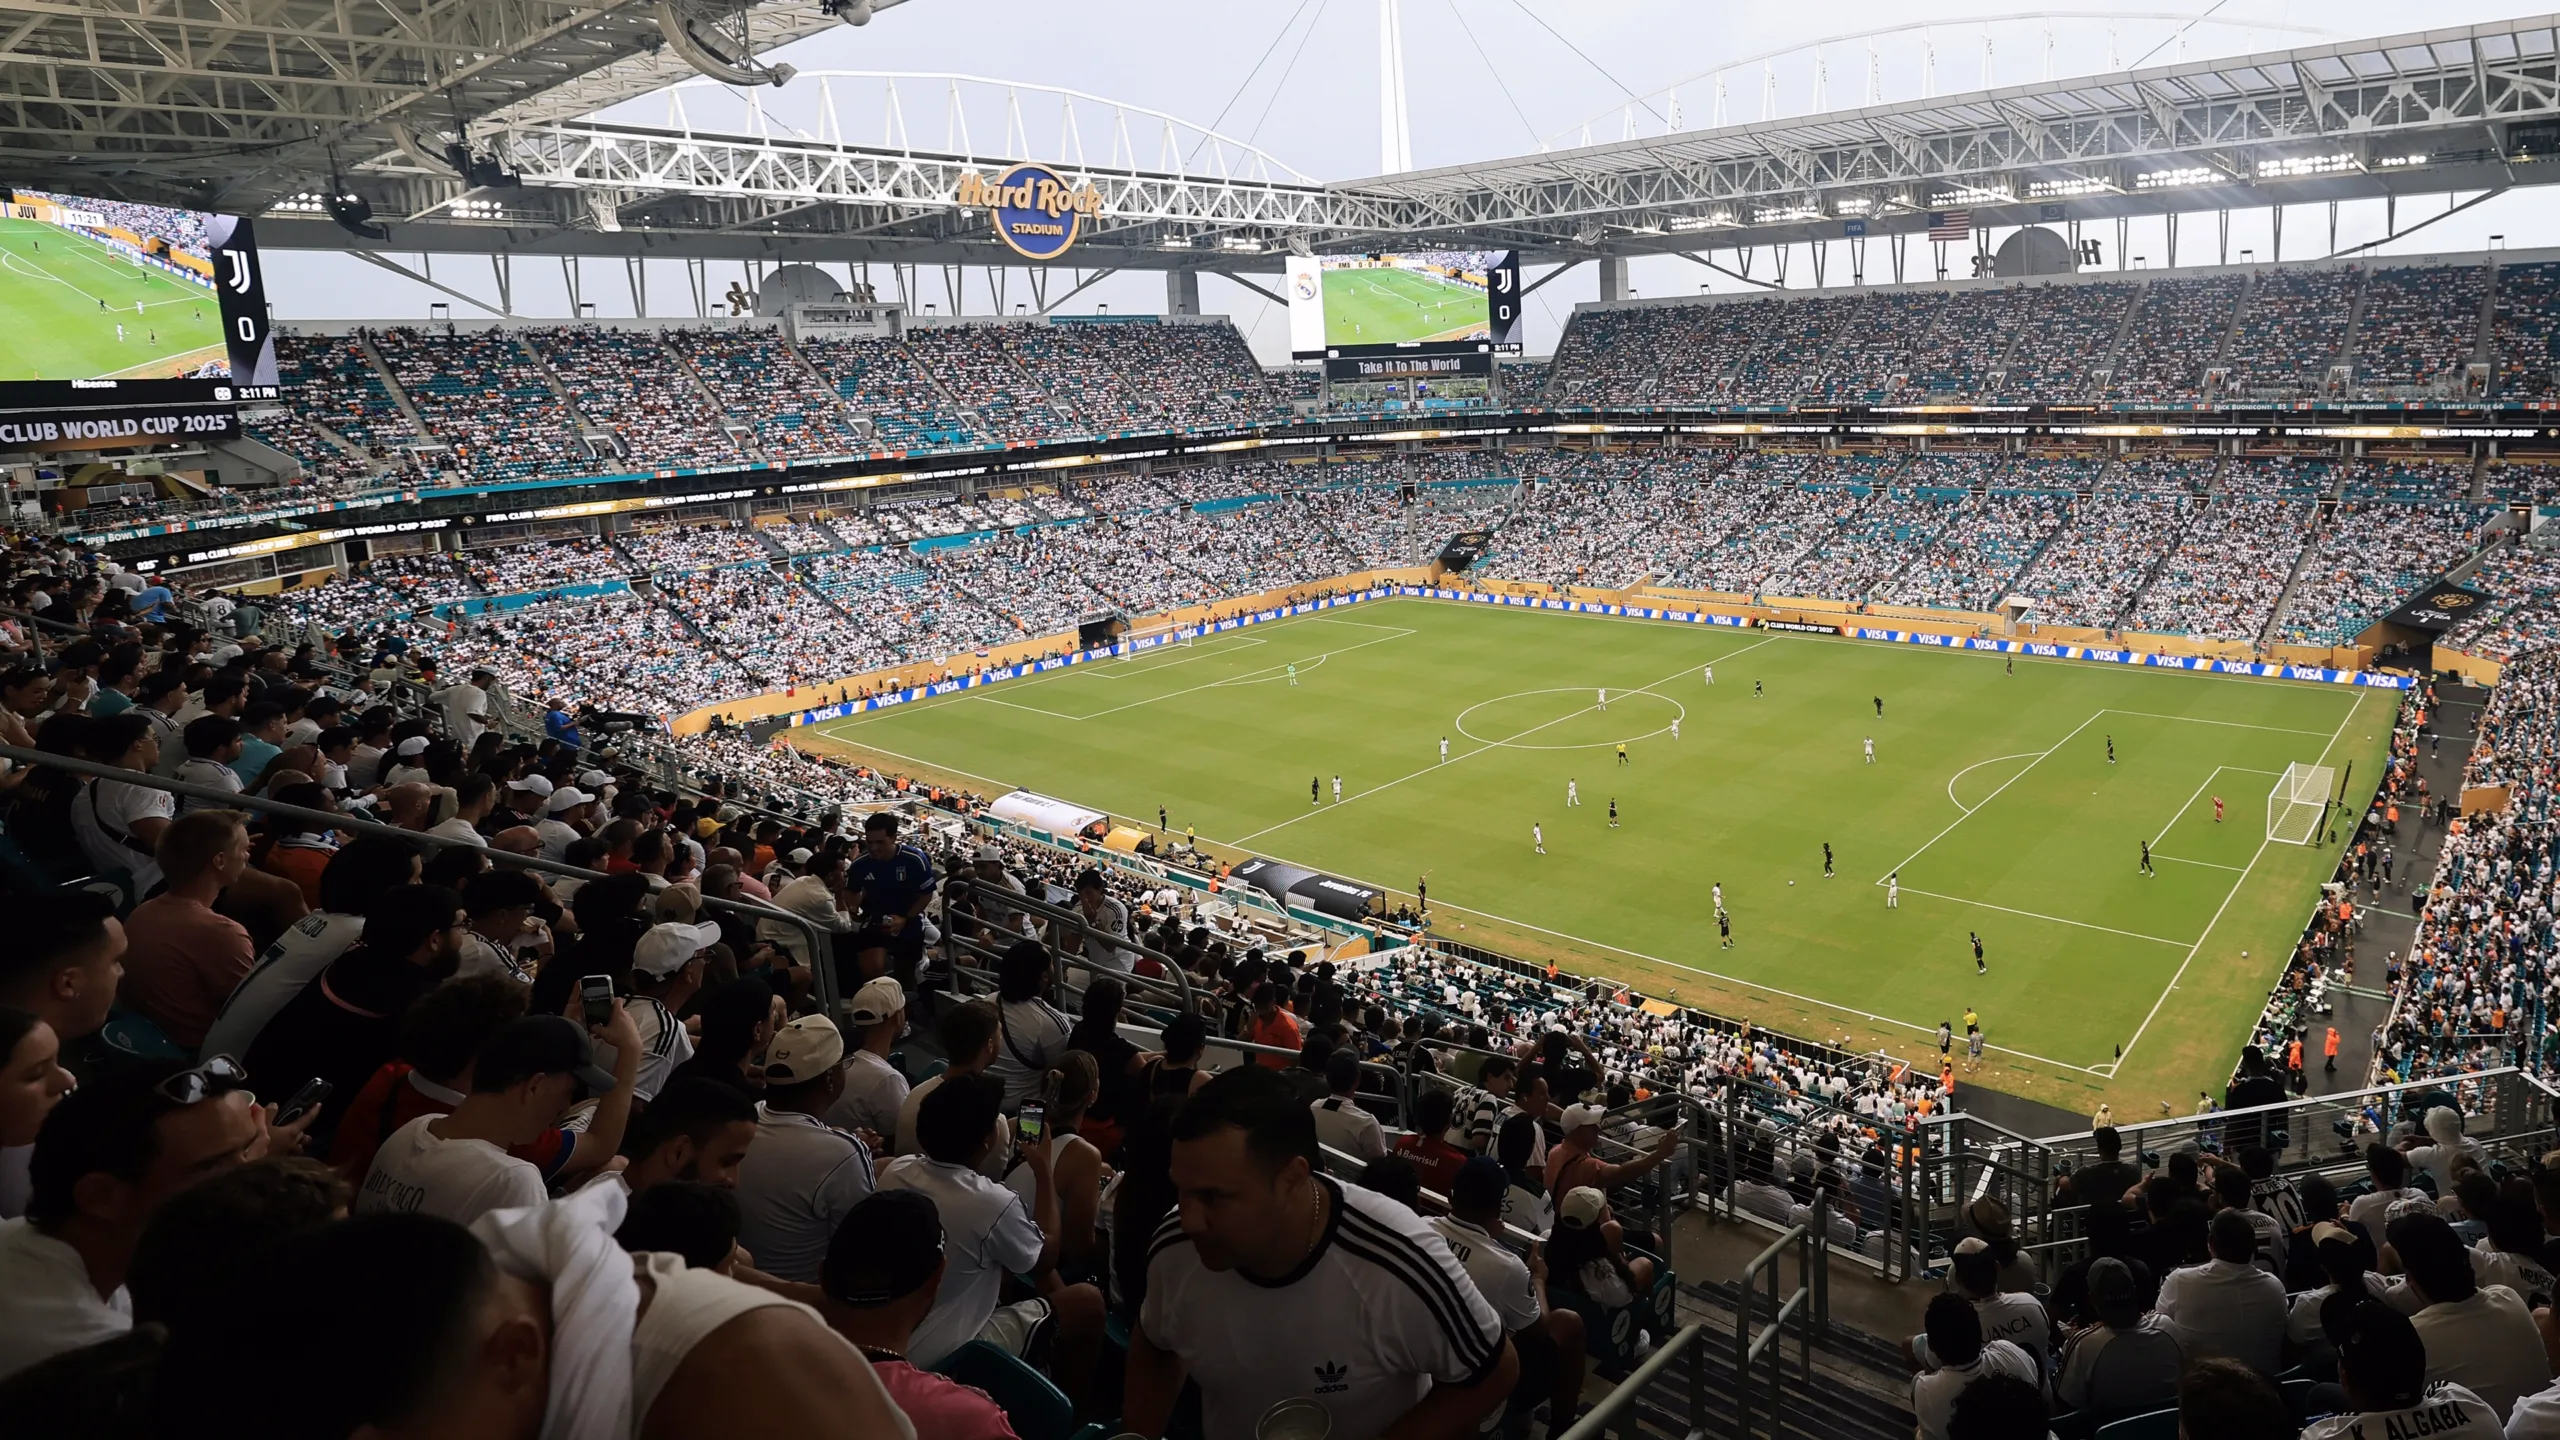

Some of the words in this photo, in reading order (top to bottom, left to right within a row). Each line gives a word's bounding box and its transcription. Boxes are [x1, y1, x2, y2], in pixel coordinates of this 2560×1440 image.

[958, 173, 1034, 210] Hard
[1036, 179, 1103, 220] Rock
[17, 206, 37, 220] JUV
[71, 211, 99, 226] 11:21
[1012, 223, 1064, 236] STADIUM
[1499, 305, 1510, 320] 0
[237, 316, 256, 342] 0
[1358, 361, 1384, 375] Take
[1385, 360, 1394, 374] It
[1396, 360, 1409, 374] To
[1410, 359, 1429, 373] The
[1431, 358, 1460, 372] World
[72, 379, 117, 390] Hisense
[240, 387, 261, 399] 3:11
[262, 386, 277, 399] PM
[0, 419, 59, 443] CLUB
[61, 415, 138, 440] WORLD
[142, 413, 180, 435] CUP
[2461, 429, 2493, 437] WORLD
[686, 493, 716, 502] WORLD
[195, 519, 218, 530] 1972
[219, 515, 248, 527] PERFECT
[248, 512, 277, 523] SEASON
[277, 510, 296, 520] TEAM
[297, 507, 315, 517] 17-0
[486, 513, 508, 523] FIFA
[508, 511, 534, 520] CLUB
[107, 529, 135, 543] BOWL
[136, 526, 150, 538] VII
[355, 524, 396, 536] WORLD
[397, 522, 419, 531] CUP
[188, 552, 208, 563] FIFA
[208, 548, 229, 560] CLUB
[1712, 614, 1732, 625] VISA
[1785, 623, 1805, 631] WORLD
[1866, 629, 1888, 640] VISA
[1917, 634, 1942, 645] VISA
[1973, 639, 1998, 651] VISA
[2031, 644, 2057, 656] VISA
[1089, 647, 1111, 659] VISA
[2092, 650, 2119, 662] VISA
[1041, 658, 1064, 669] VISA
[2155, 655, 2183, 668] VISA
[2222, 660, 2251, 674] VISA
[990, 670, 1014, 683] VISA
[2292, 667, 2323, 681] VISA
[2365, 673, 2398, 688] VISA
[934, 682, 959, 695] VISA
[877, 694, 904, 708] VISA
[813, 706, 842, 721] VISA
[1403, 1149, 1439, 1167] Banrisul
[2262, 1190, 2304, 1238] 10
[1314, 1383, 1349, 1394] adidas
[2385, 1400, 2472, 1440] ALGABA
